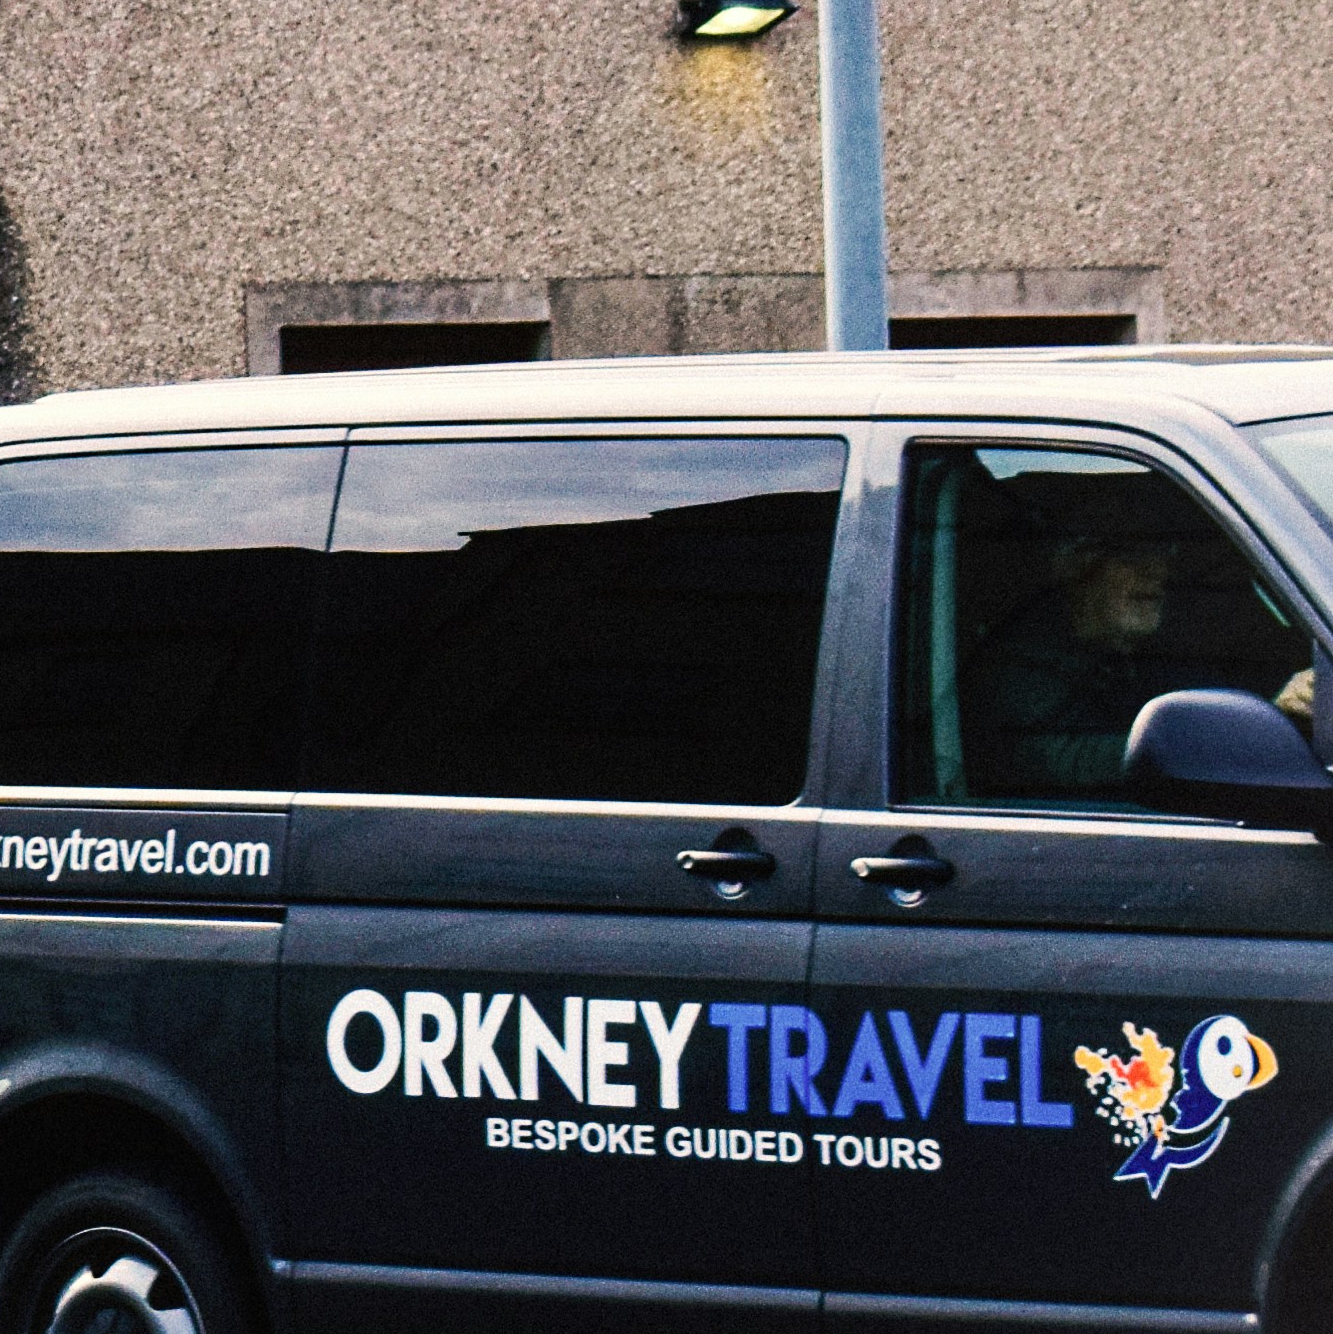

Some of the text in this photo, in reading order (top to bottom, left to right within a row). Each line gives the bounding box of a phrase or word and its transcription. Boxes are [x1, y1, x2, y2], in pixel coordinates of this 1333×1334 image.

[485, 1116, 943, 1172] BESPOKE GUIDED TOURS
